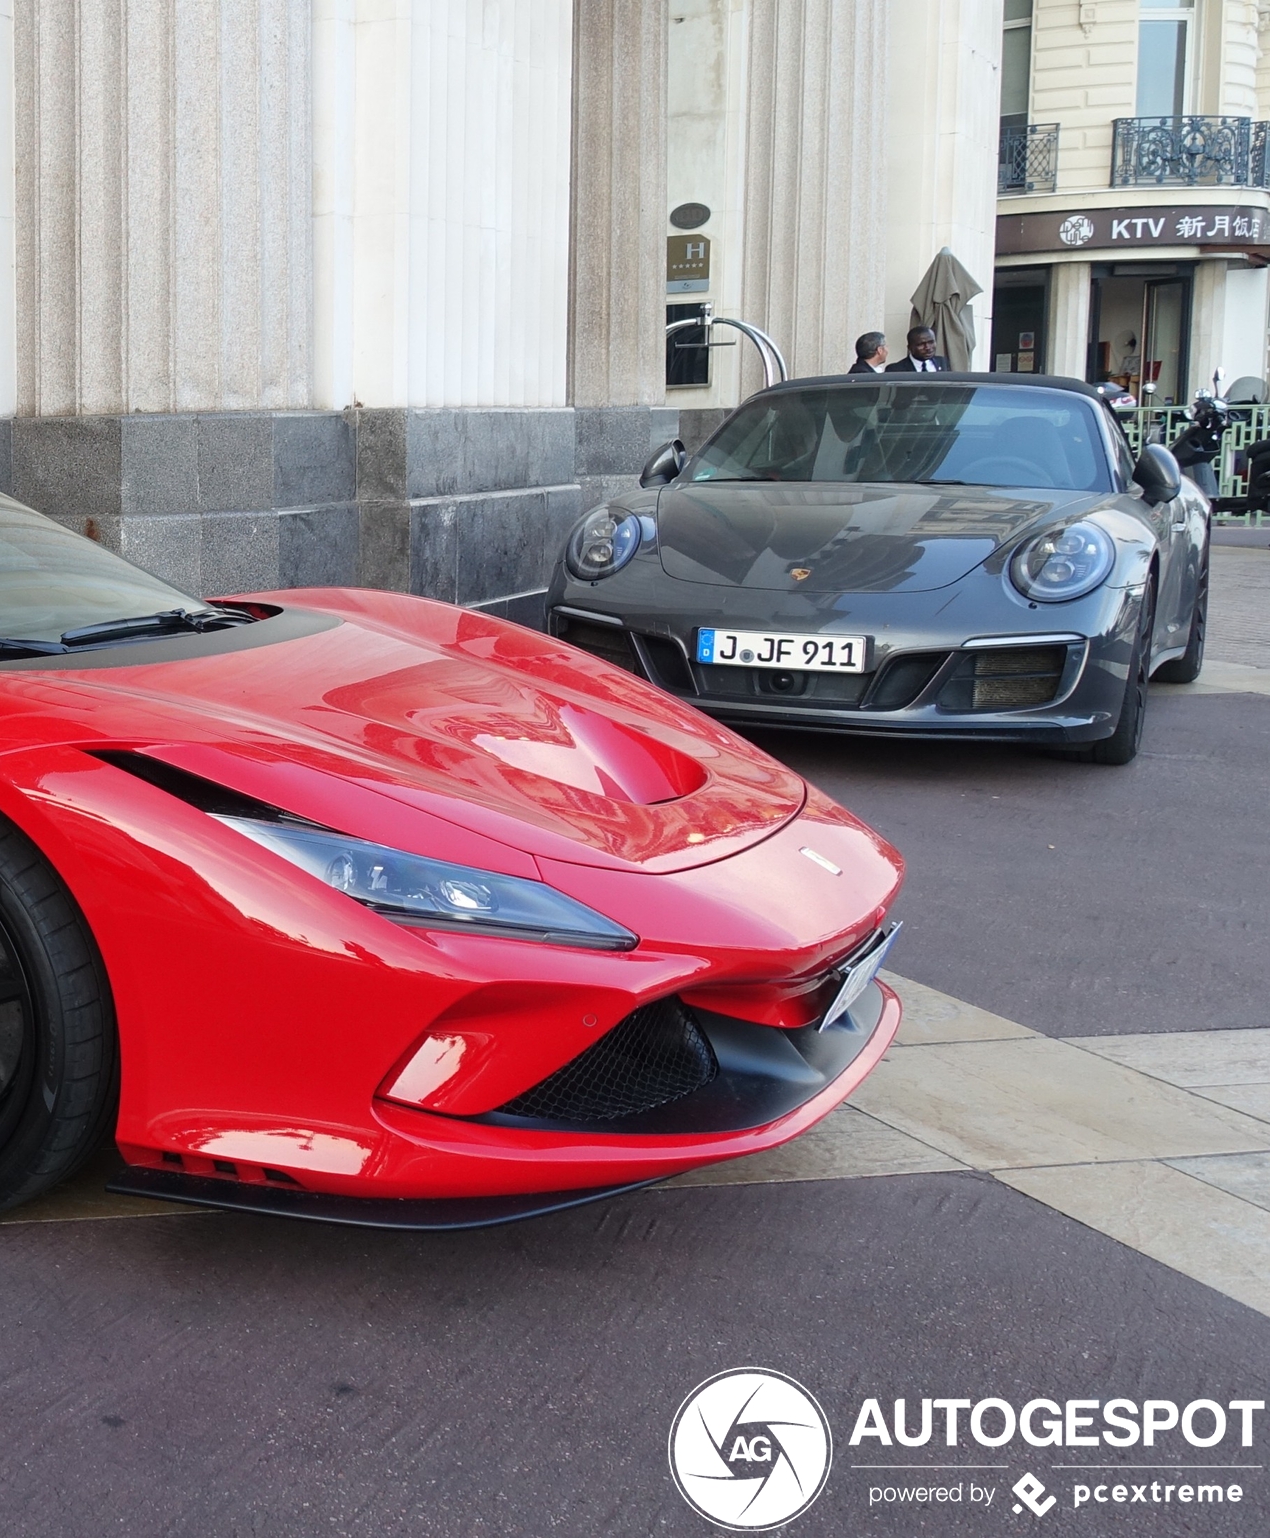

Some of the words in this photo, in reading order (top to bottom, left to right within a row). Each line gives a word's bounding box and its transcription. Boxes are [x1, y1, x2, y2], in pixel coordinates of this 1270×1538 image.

[1111, 217, 1166, 240] KTV
[686, 242, 705, 260] H
[703, 648, 709, 657] D
[720, 635, 737, 660] J
[757, 637, 794, 663] JF
[802, 640, 856, 667] 911
